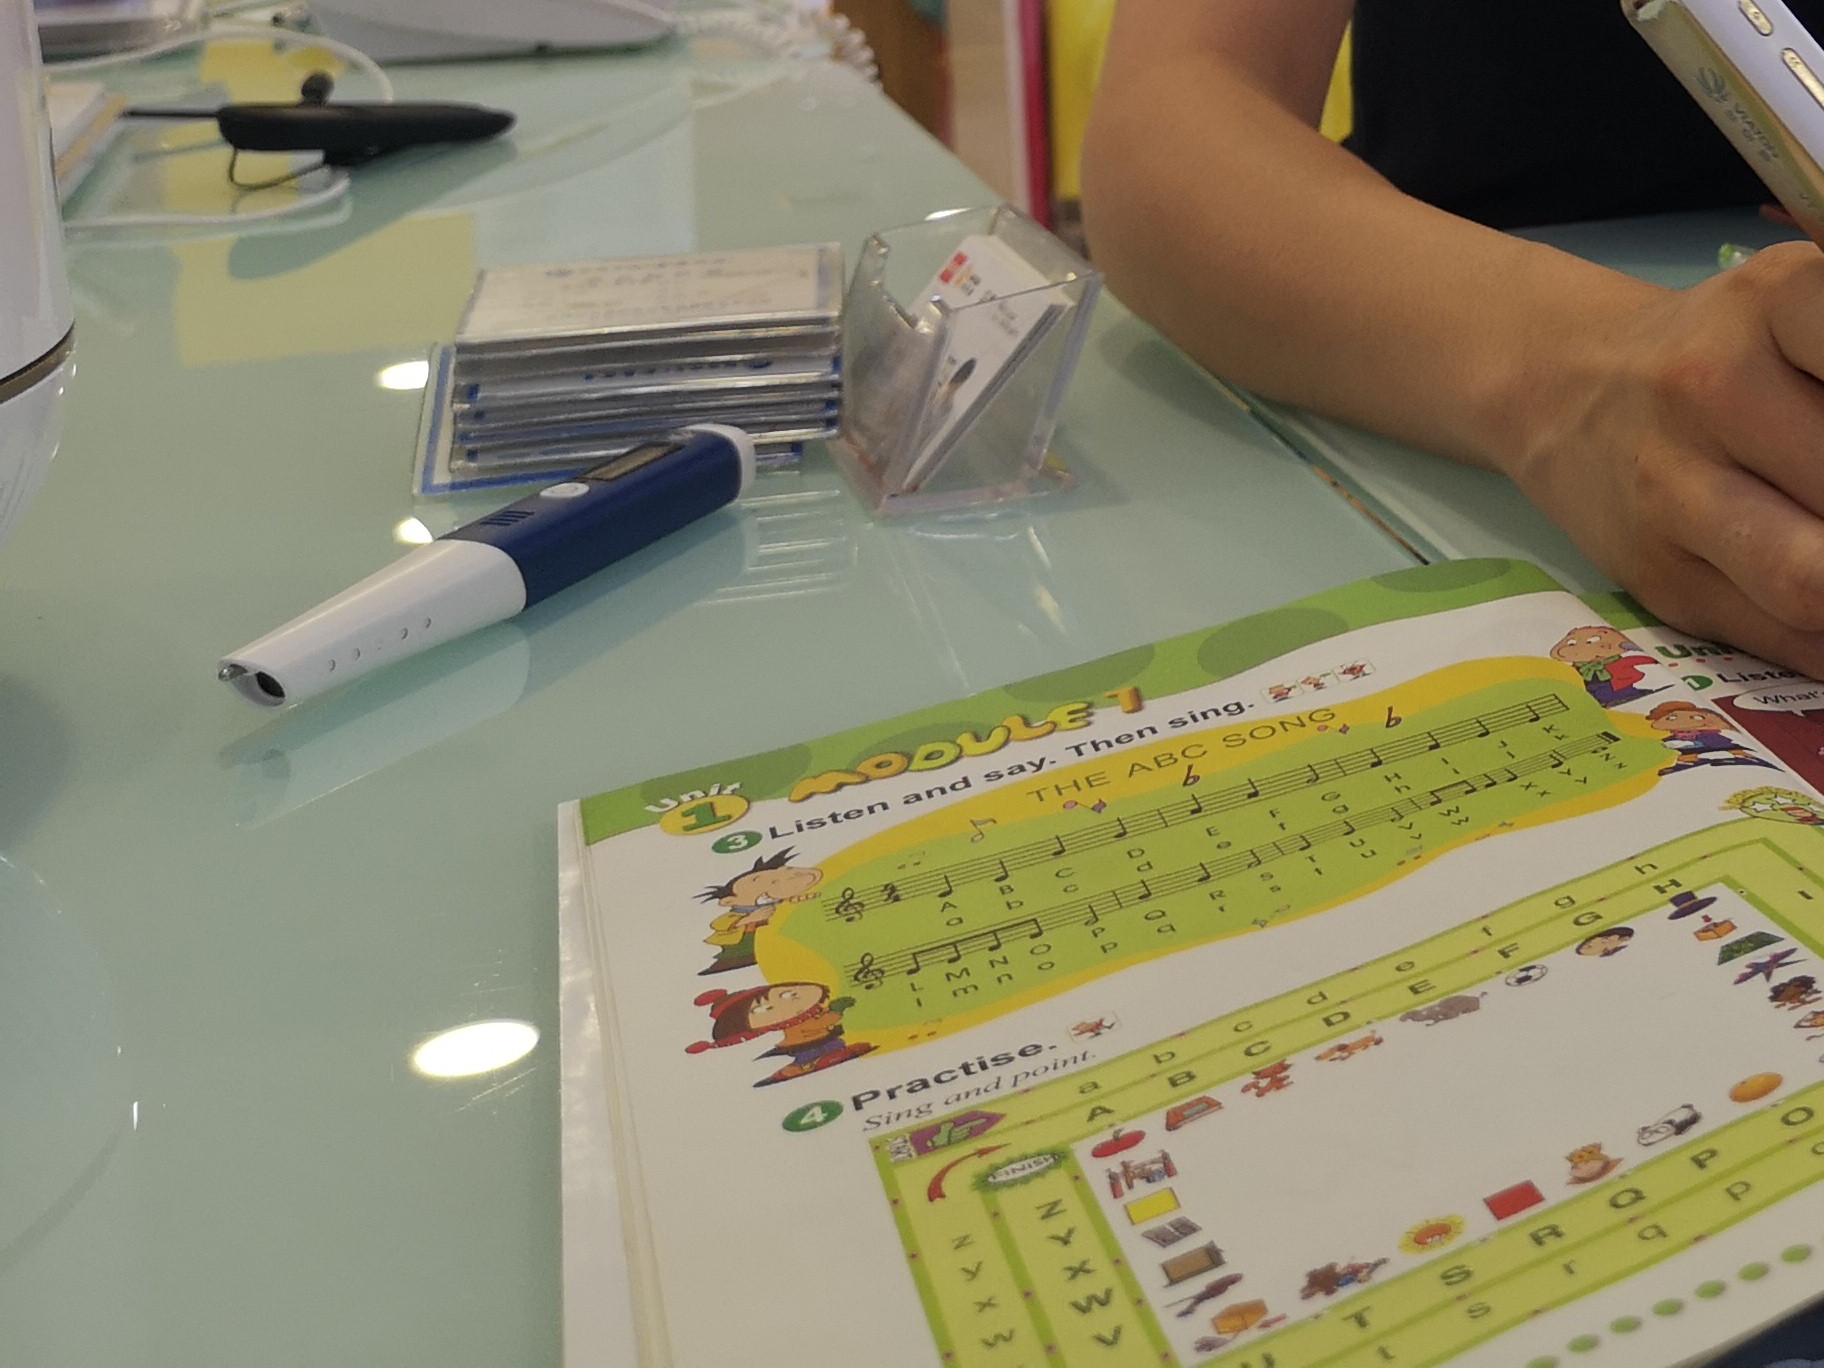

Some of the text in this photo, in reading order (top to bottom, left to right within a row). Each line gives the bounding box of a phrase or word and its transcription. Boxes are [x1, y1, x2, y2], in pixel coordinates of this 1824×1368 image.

[1716, 670, 1799, 683] Liste
[644, 782, 742, 813] Unit
[769, 798, 891, 840] Listen
[902, 776, 974, 806] and
[983, 755, 1058, 784] say.
[1065, 724, 1158, 757] Then
[1167, 700, 1255, 730] sing.
[788, 701, 1097, 803] MODULE
[1026, 707, 1337, 803] THE ABC SONG
[682, 801, 732, 832] 1
[940, 901, 957, 913] A
[999, 884, 1015, 895] B
[1054, 867, 1076, 879] C
[1127, 848, 1145, 860] D
[1384, 772, 1402, 783] H
[1542, 724, 1558, 734] K
[1798, 890, 1814, 901] I
[1086, 878, 1683, 1122] A B C D E F G H
[851, 1042, 1058, 1112] Practise.
[861, 1050, 1097, 1132] Sing and point.
[1341, 1306, 1373, 1329] T
[1439, 1264, 1475, 1286] S
[1528, 1223, 1567, 1247] R
[1608, 1187, 1647, 1209] Q
[1690, 1148, 1719, 1170] P
[1781, 1106, 1815, 1126] O
[1035, 1198, 1123, 1347] Z Y X W V
